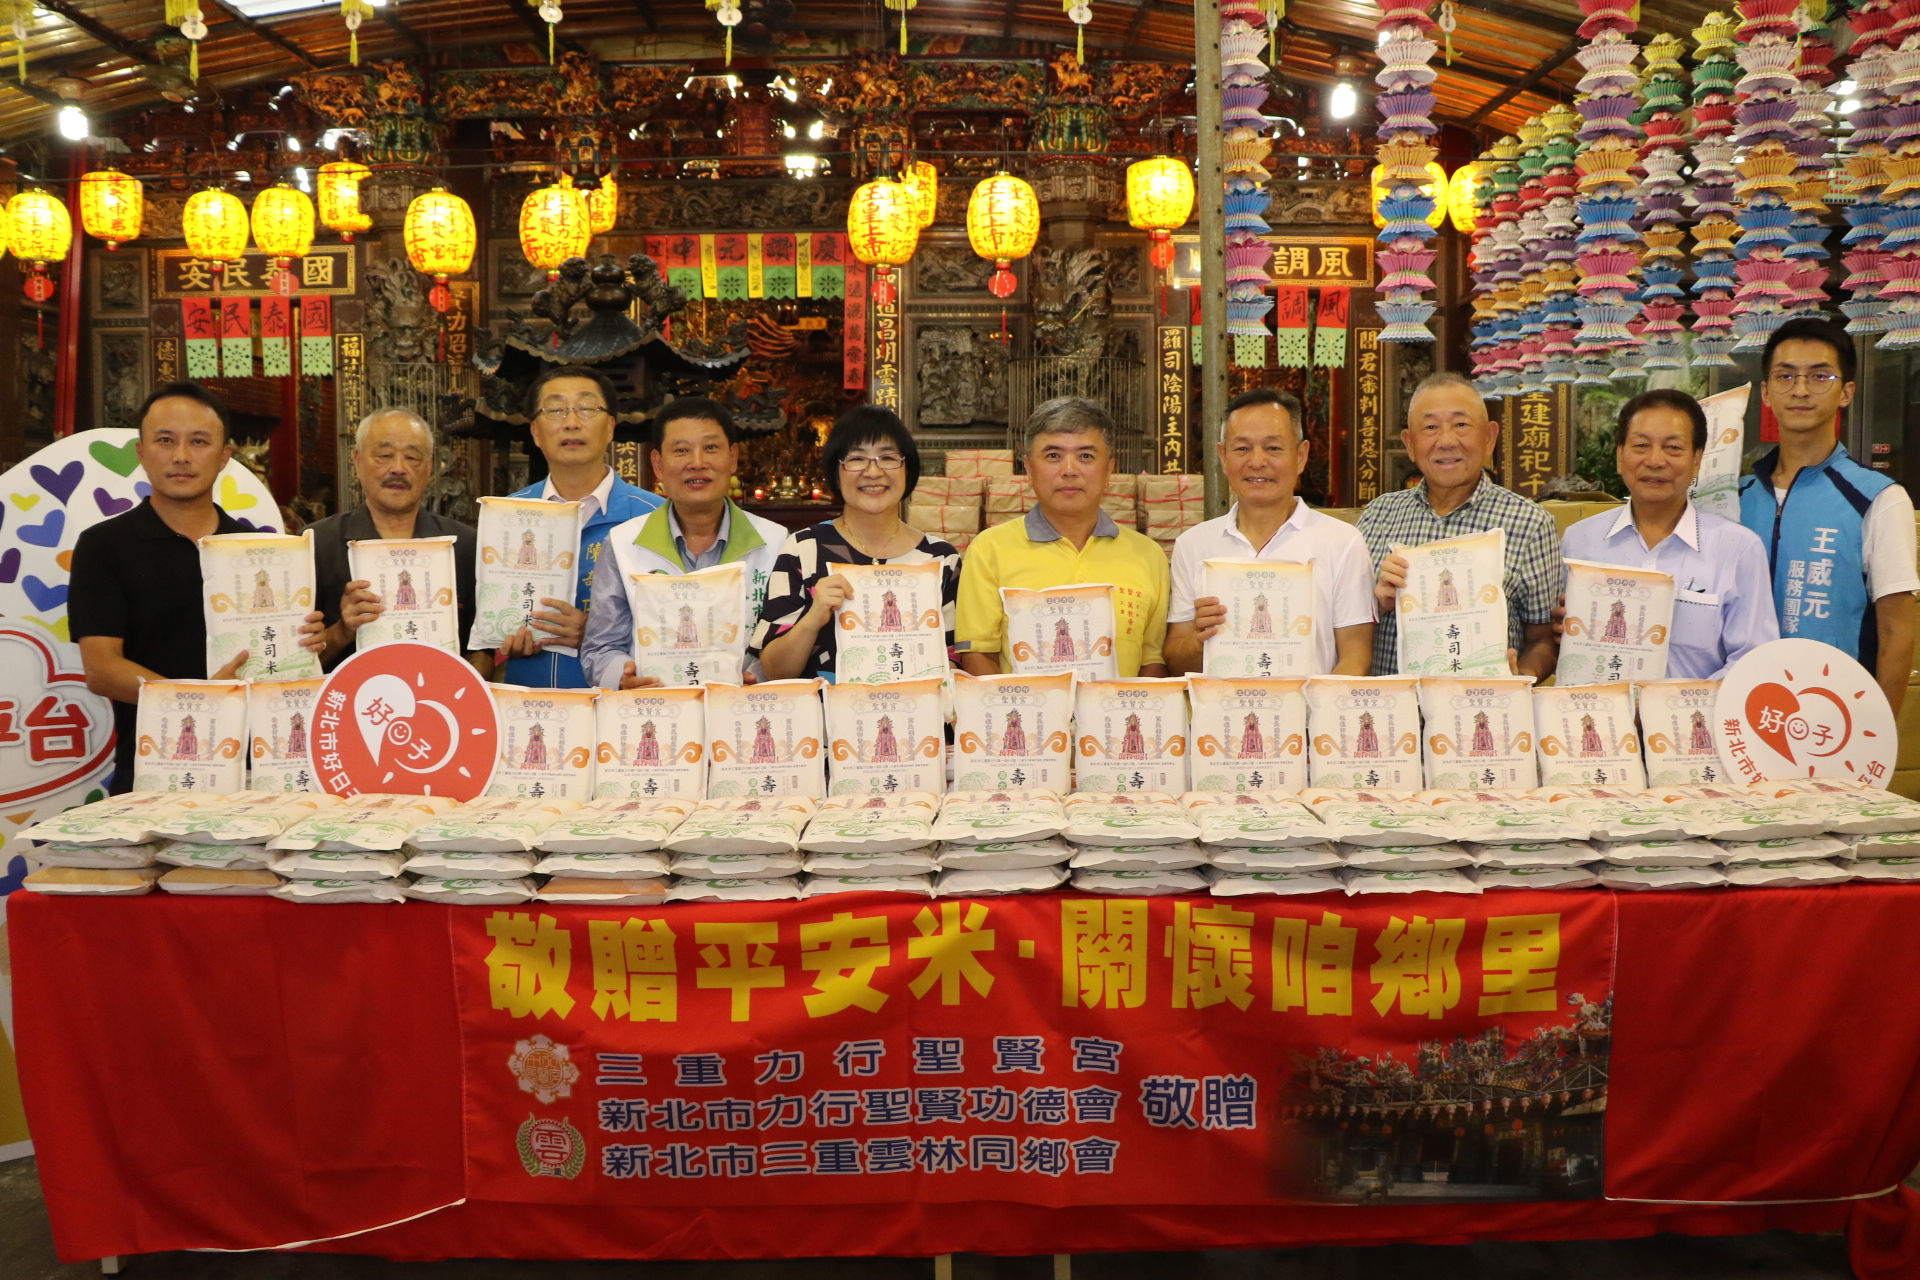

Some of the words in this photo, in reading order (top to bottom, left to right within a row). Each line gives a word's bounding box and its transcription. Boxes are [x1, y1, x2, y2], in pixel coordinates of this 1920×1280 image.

[1782, 560, 1806, 634] 服務團隊
[1803, 527, 1839, 619] 王威元
[521, 581, 535, 627] 壽司米
[752, 569, 767, 636] 新北市
[262, 626, 278, 675] 壽司米
[404, 620, 418, 640] 壽
[1445, 624, 1462, 672] 壽司米
[361, 697, 394, 726] 好
[407, 738, 432, 760] 子
[1758, 705, 1785, 734] 好
[1812, 724, 1834, 746] 子
[596, 1036, 1123, 1087] 三重力行聖賢宮
[598, 1084, 1122, 1132] 新北市力行聖賢功德會
[1138, 1073, 1258, 1130] 敬贈
[602, 1134, 1120, 1178] 新北市三重雲林同鄉會
